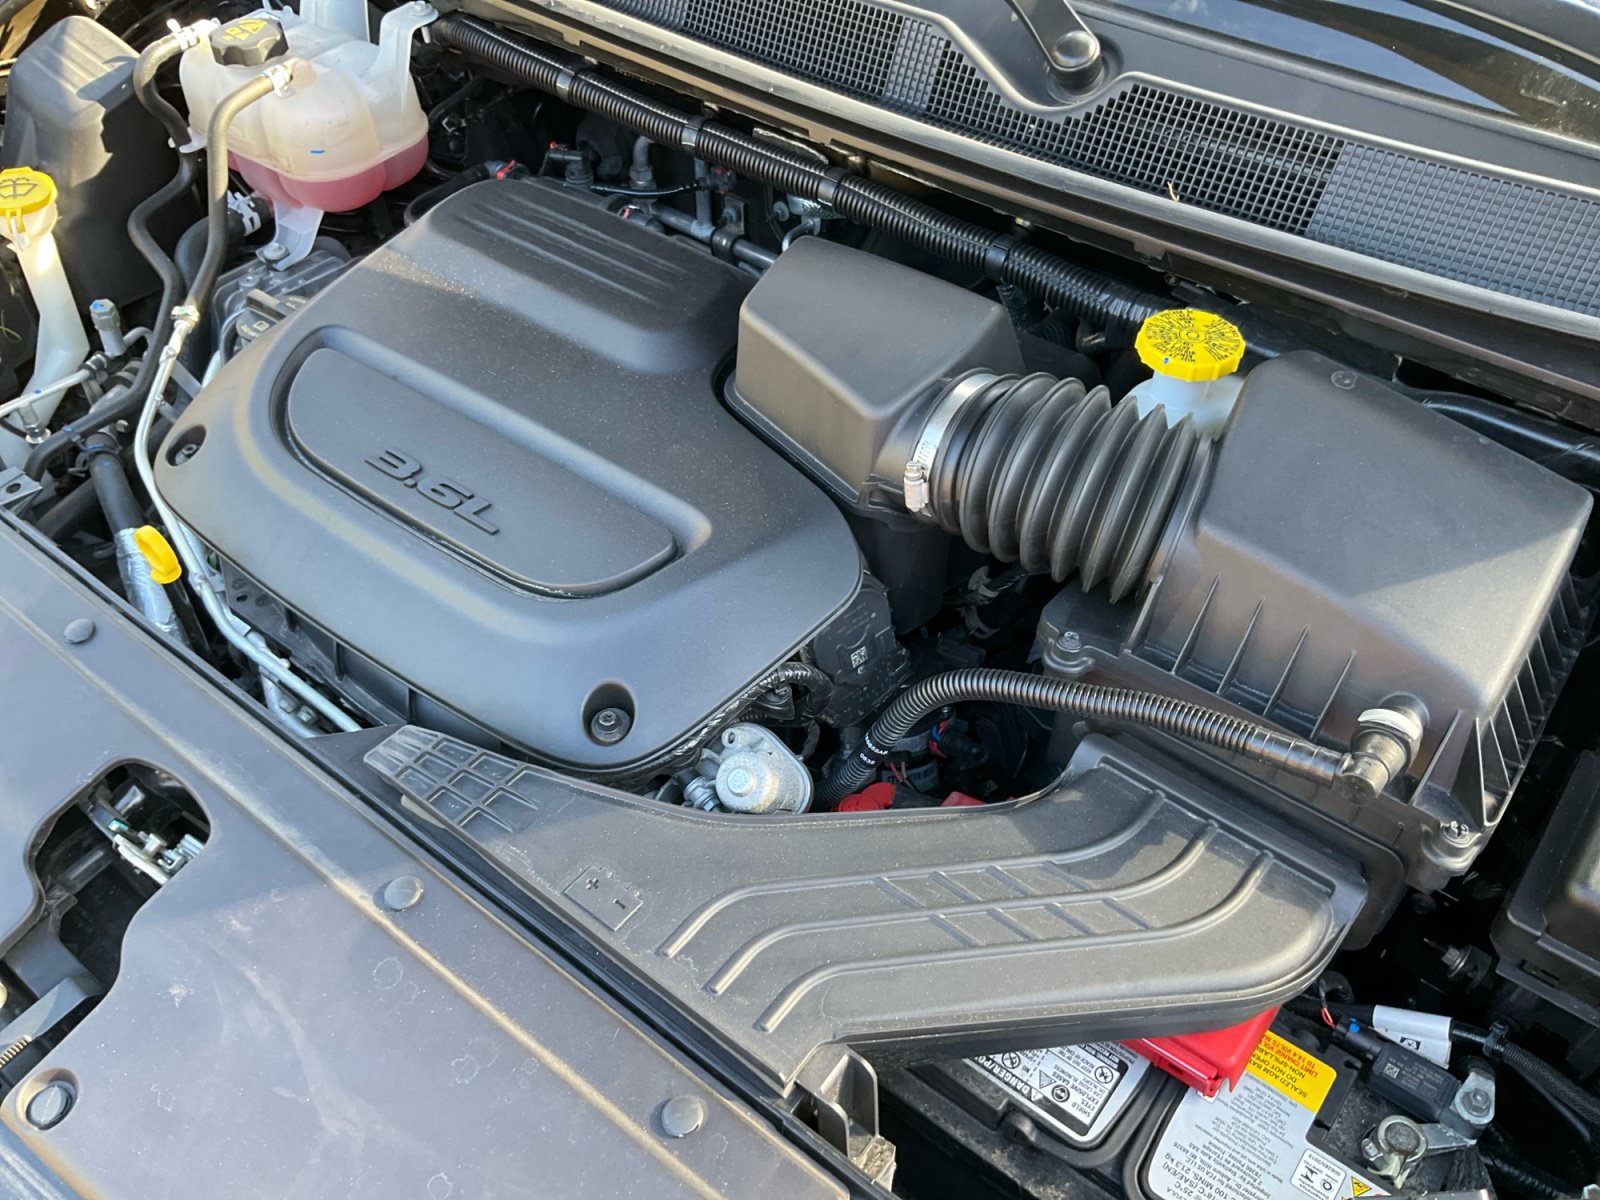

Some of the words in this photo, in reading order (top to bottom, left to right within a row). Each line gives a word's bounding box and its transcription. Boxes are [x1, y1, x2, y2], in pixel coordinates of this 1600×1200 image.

[364, 446, 500, 536] 3.6L
[1058, 1049, 1066, 1057] THE
[1060, 1044, 1075, 1056] CHILD
[1271, 1039, 1292, 1054] VOLTS
[1071, 1058, 1081, 1066] OUT
[1080, 1057, 1095, 1069] REACH
[1275, 1048, 1300, 1067] CHARGE
[1292, 1051, 1306, 1062] 14.4
[1021, 1064, 1030, 1073] NO
[1080, 1064, 1092, 1073] KEEP
[1248, 1058, 1262, 1069] BAT
[1270, 1063, 1285, 1076] NOT
[1306, 1060, 1315, 1068] TO
[972, 1051, 1031, 1095] DANGER/PO
[1053, 1063, 1078, 1082] BLINDNESS
[1262, 1066, 1279, 1080] AGM
[1299, 1063, 1318, 1078] LIMIT
[1051, 1070, 1070, 1085] GASES
[1285, 1073, 1297, 1083] DO
[1077, 1080, 1093, 1092] CAUSE
[1278, 1076, 1308, 1098] SEALED
[1069, 1082, 1099, 1105] EXPLOSIVE
[1092, 1090, 1102, 1099] CAN
[1070, 1101, 1091, 1117] SHIELD
[1187, 1141, 1200, 1152] SAS
[1207, 1140, 1226, 1154] France
[1163, 1151, 1176, 1164] kg
[1199, 1149, 1212, 1160] Auto
[1174, 1160, 1190, 1174] 21.3
[1196, 1163, 1205, 1172] US
[1211, 1157, 1237, 1176] Stellantis
[1230, 1162, 1258, 1182] Boulevard
[1161, 1161, 1198, 1189] (SAE/EN)
[1204, 1169, 1216, 1179] FCA
[1211, 1166, 1231, 1181] Auburn
[1216, 1177, 1225, 1185] for
[1165, 1186, 1185, 1200] VULA
[1173, 1180, 1193, 1196] 25°C
[1213, 1186, 1228, 1199] 100
[1245, 1179, 1271, 1198] Imported
